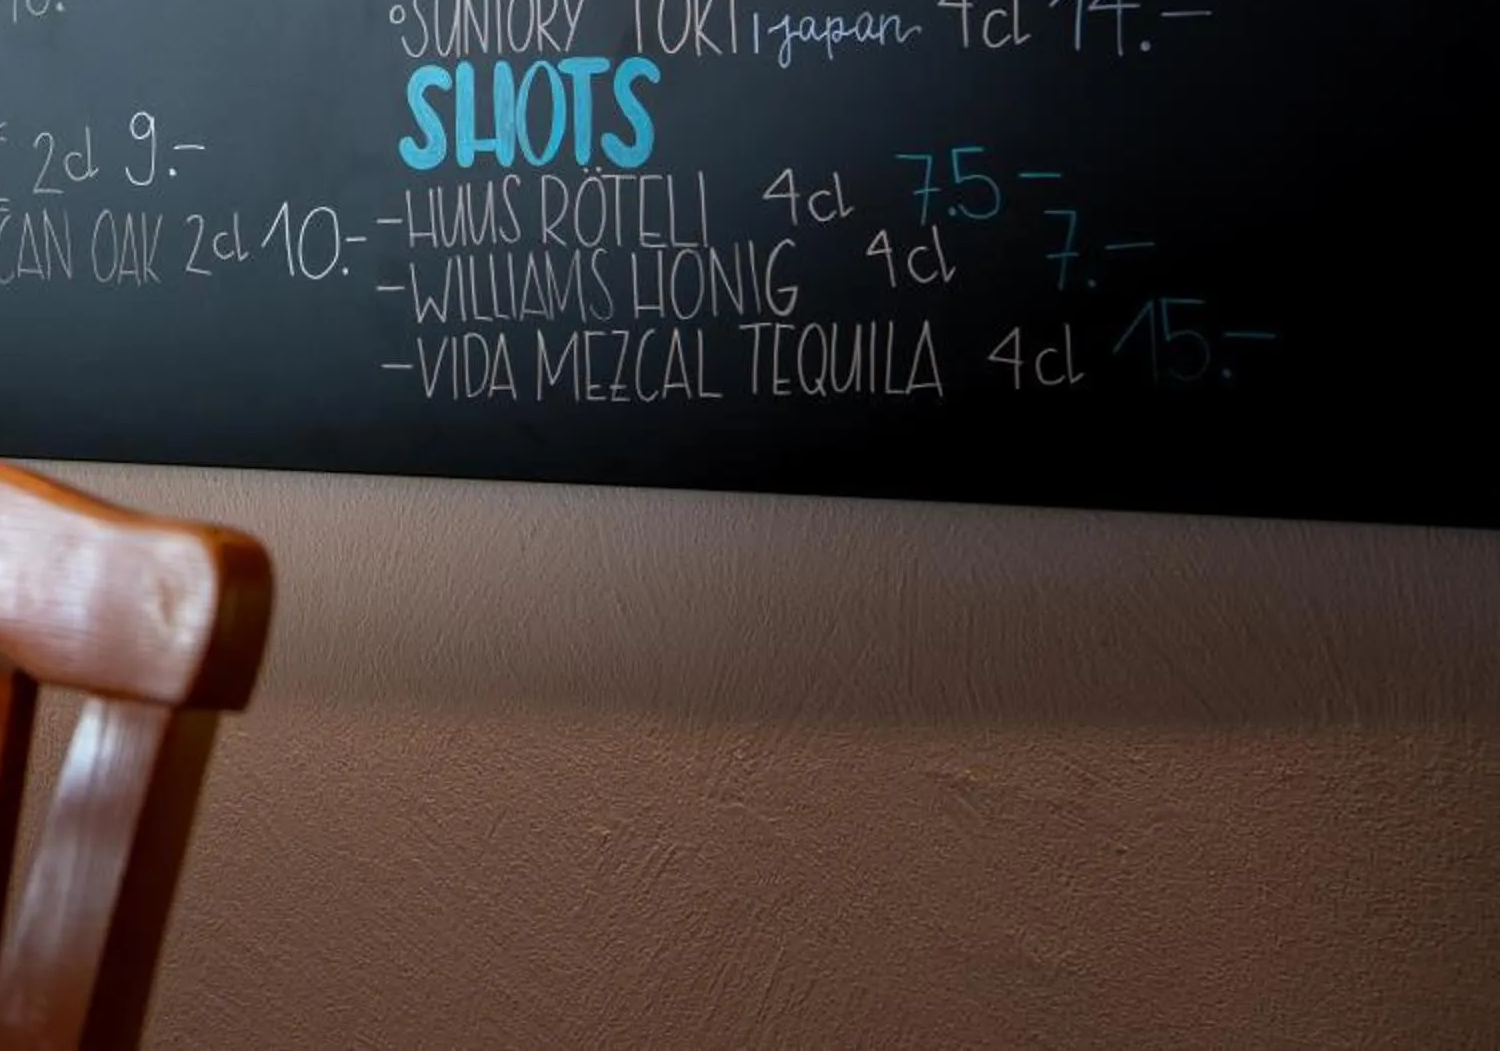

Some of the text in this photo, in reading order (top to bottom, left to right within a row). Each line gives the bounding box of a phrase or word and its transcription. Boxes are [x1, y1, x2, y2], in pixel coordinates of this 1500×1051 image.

[399, 55, 662, 171] SHOTS
[90, 207, 163, 286] OAK
[405, 173, 522, 249] HUUS
[762, 167, 856, 226] 4cl
[409, 247, 615, 325] WILLIAMS
[631, 238, 800, 321] HONIG
[866, 224, 957, 289] 4cl
[416, 328, 519, 401] VIDA
[536, 326, 724, 404] MEZCAL
[739, 319, 944, 398] TEQUILA
[988, 323, 1086, 391] 4cl
